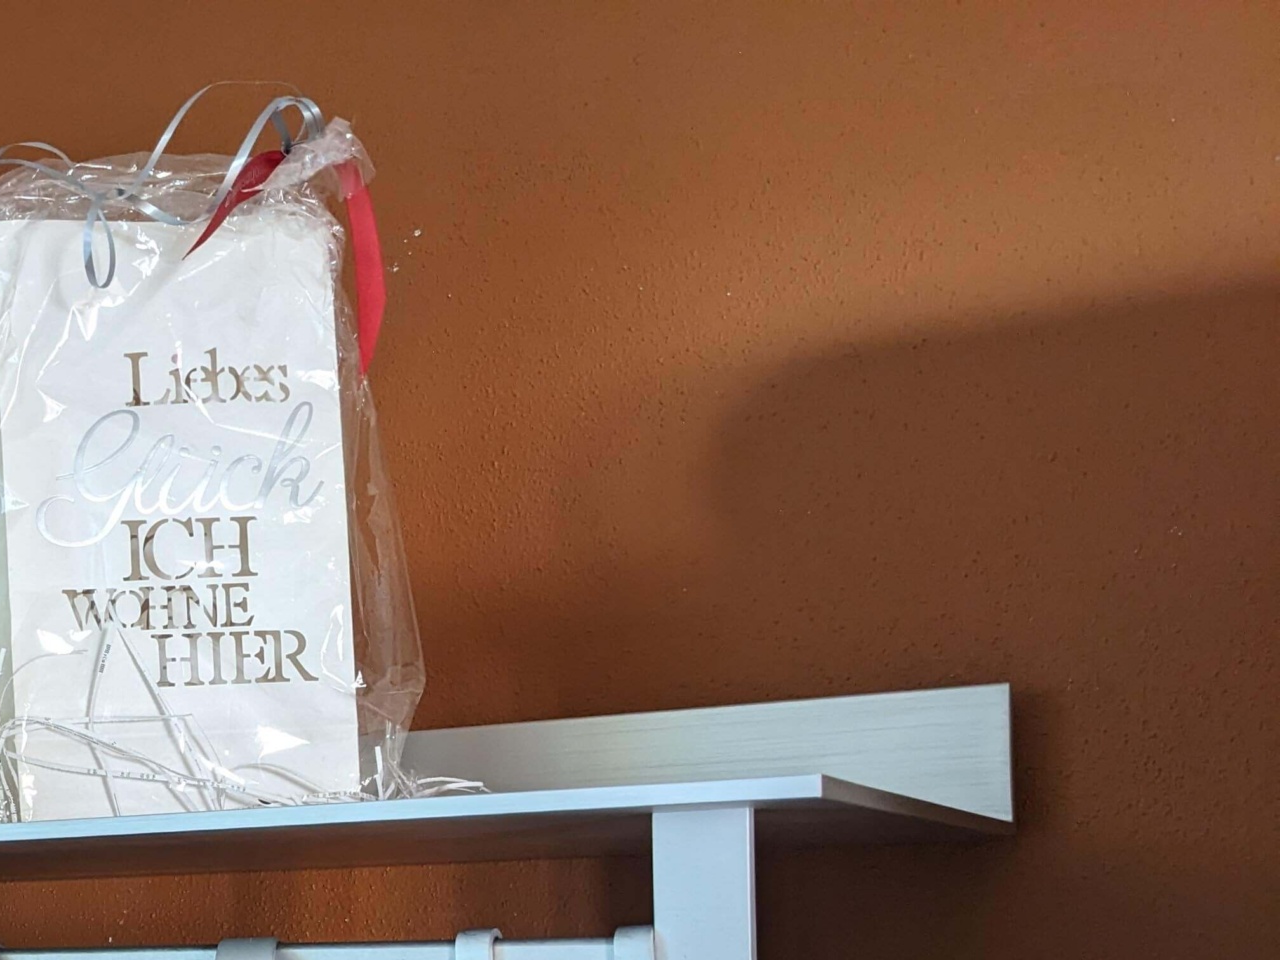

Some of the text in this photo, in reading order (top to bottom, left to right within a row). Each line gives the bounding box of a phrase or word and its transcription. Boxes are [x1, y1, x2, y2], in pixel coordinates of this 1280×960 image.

[123, 347, 291, 407] Liebes
[36, 401, 324, 546] Glück
[121, 516, 258, 581] ICH
[62, 583, 254, 631] WOHNE
[151, 631, 319, 686] HIER
